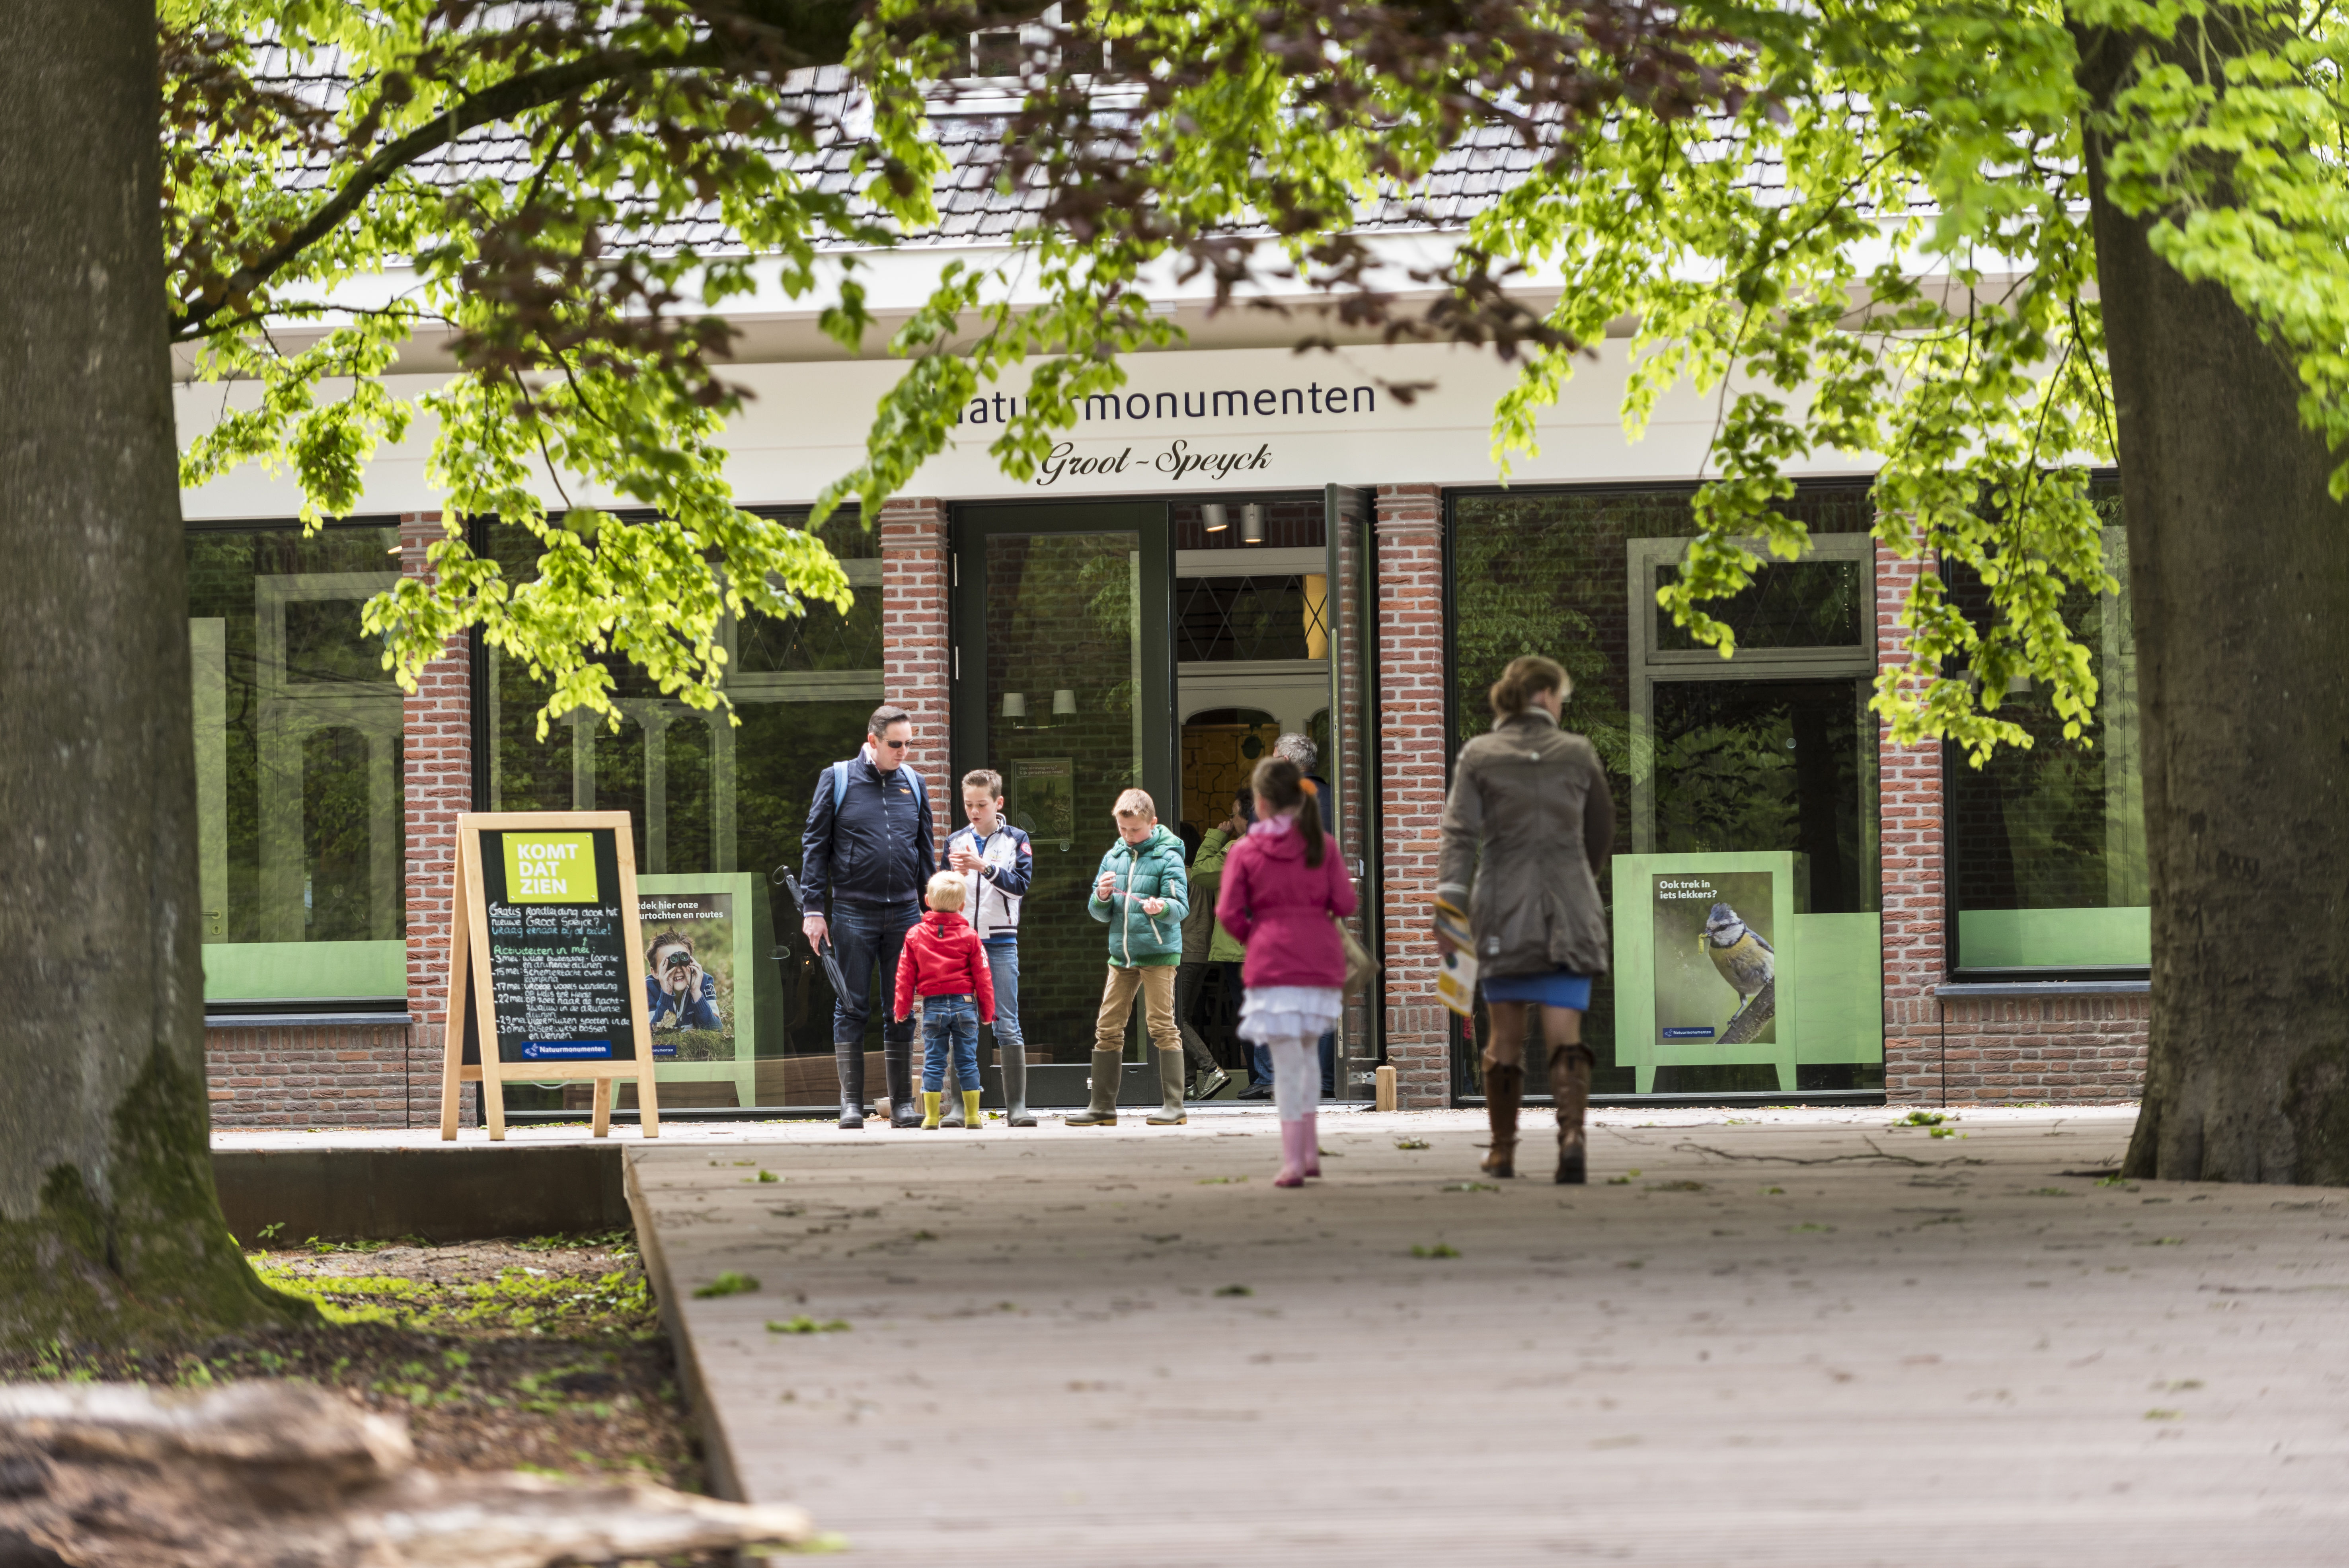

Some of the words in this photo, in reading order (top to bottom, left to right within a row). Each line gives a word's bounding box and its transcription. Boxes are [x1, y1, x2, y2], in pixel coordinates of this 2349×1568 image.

[932, 382, 1375, 424] atumonumenten
[1036, 442, 1132, 486] Groot
[1155, 439, 1272, 481] Speyck
[517, 843, 579, 860] KOMT
[519, 861, 559, 877] DAT
[520, 878, 567, 894] ZIEN
[1659, 880, 1679, 889] Ook
[1680, 880, 1700, 888] trek
[1660, 891, 1676, 899] iets
[1678, 890, 1717, 899] lekkers?
[606, 903, 618, 916] het
[638, 901, 657, 909] tdek
[639, 911, 681, 919] urtochten
[494, 945, 554, 955] Activiteiten
[579, 983, 618, 993] wandeling
[580, 1017, 609, 1025] spotten
